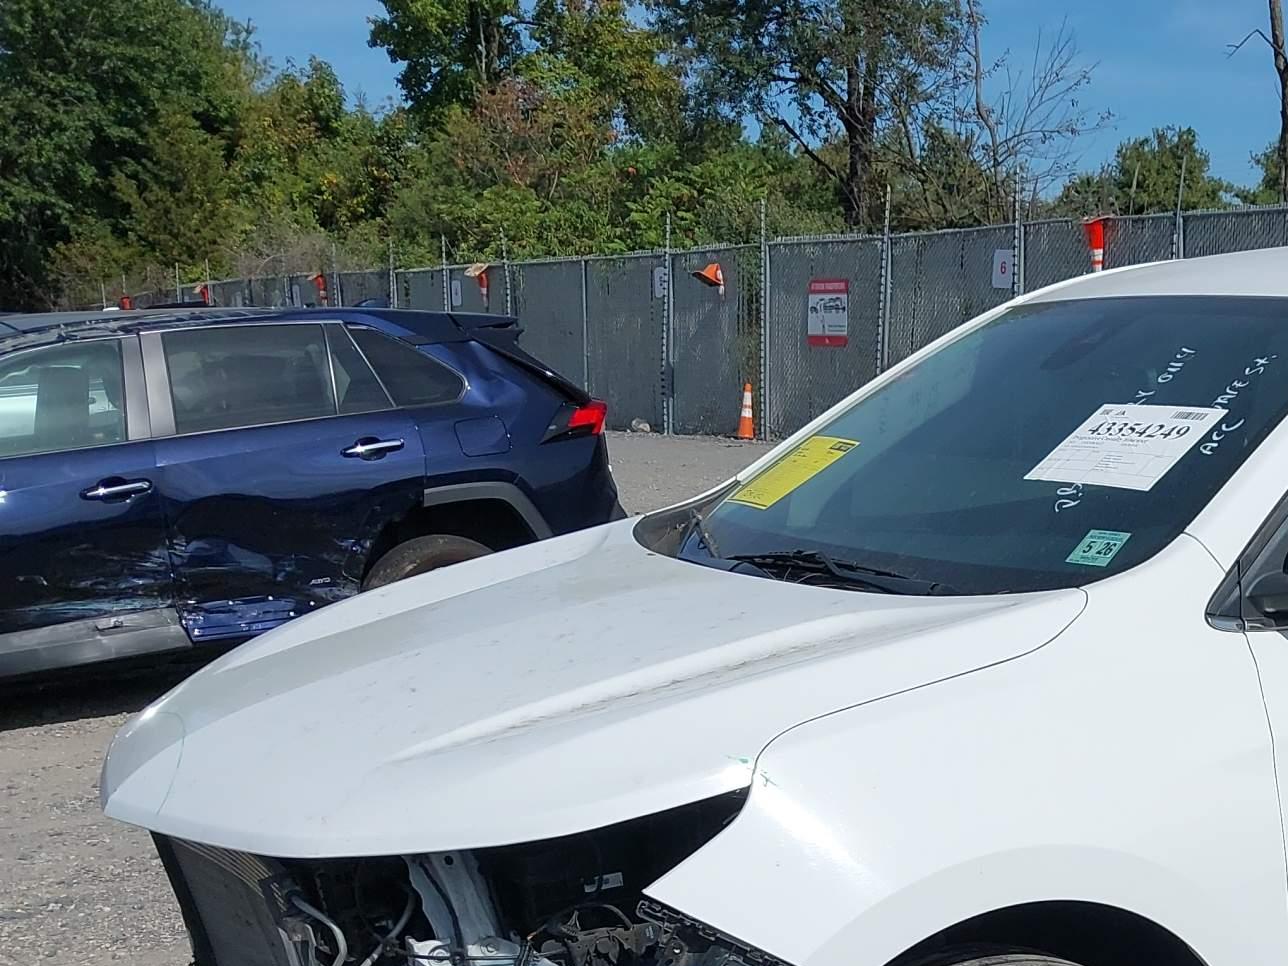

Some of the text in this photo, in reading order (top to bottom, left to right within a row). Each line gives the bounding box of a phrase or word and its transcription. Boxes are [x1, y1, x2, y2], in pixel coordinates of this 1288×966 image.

[1000, 260, 1007, 274] 6
[1087, 421, 1191, 440] 43354249
[1082, 540, 1117, 556] 5 26
